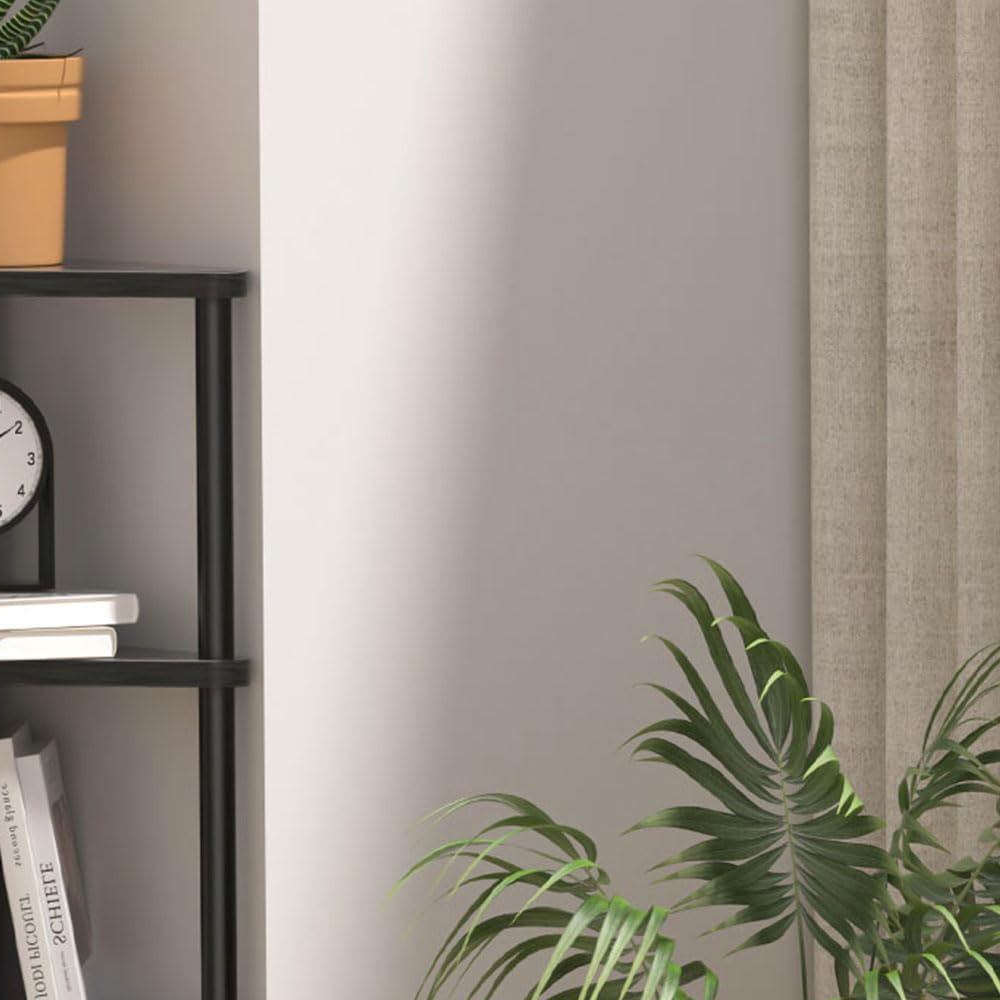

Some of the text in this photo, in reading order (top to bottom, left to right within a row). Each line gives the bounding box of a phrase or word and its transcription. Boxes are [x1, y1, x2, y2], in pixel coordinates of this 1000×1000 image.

[14, 420, 23, 435] 2
[27, 452, 36, 466] 3
[17, 484, 26, 496] 4
